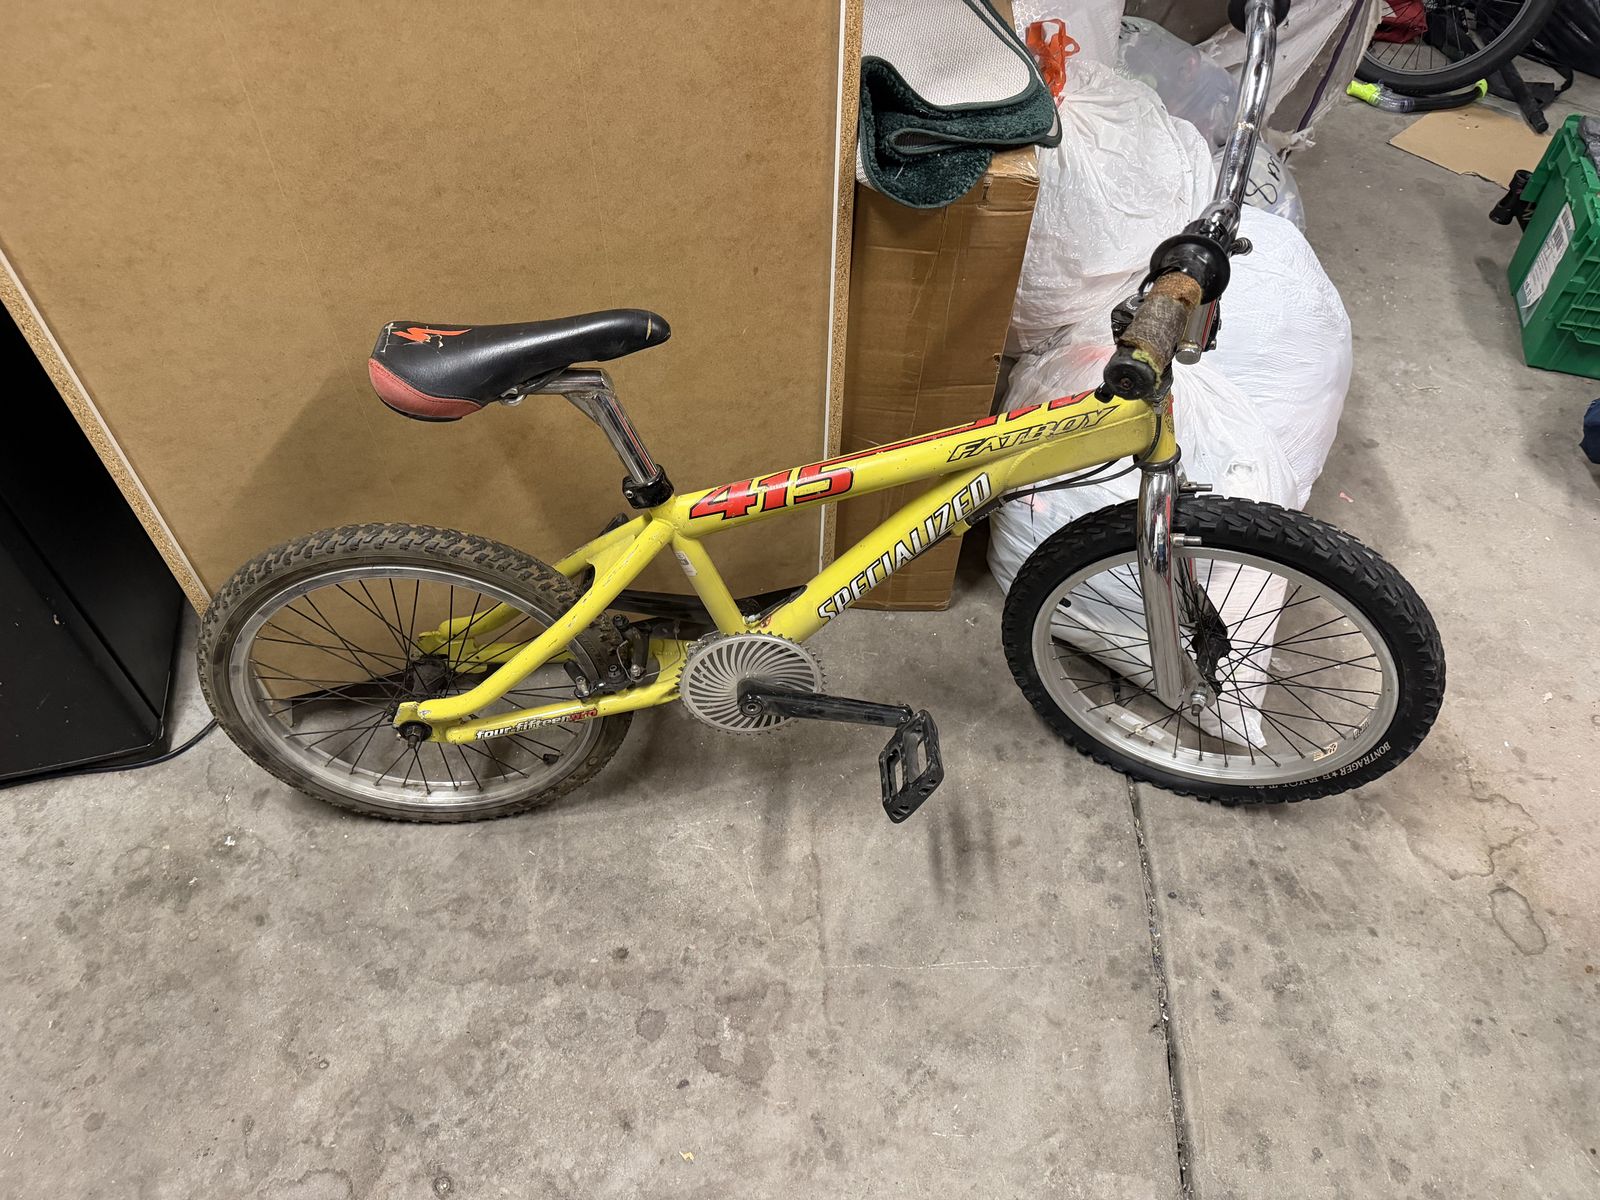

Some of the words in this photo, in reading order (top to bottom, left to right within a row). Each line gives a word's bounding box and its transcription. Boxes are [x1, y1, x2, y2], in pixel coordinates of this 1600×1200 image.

[946, 405, 1120, 462] FATBOY
[689, 464, 854, 520] 415
[817, 472, 992, 624] SPECIALIZED
[1339, 740, 1391, 776] BONTRAGER
